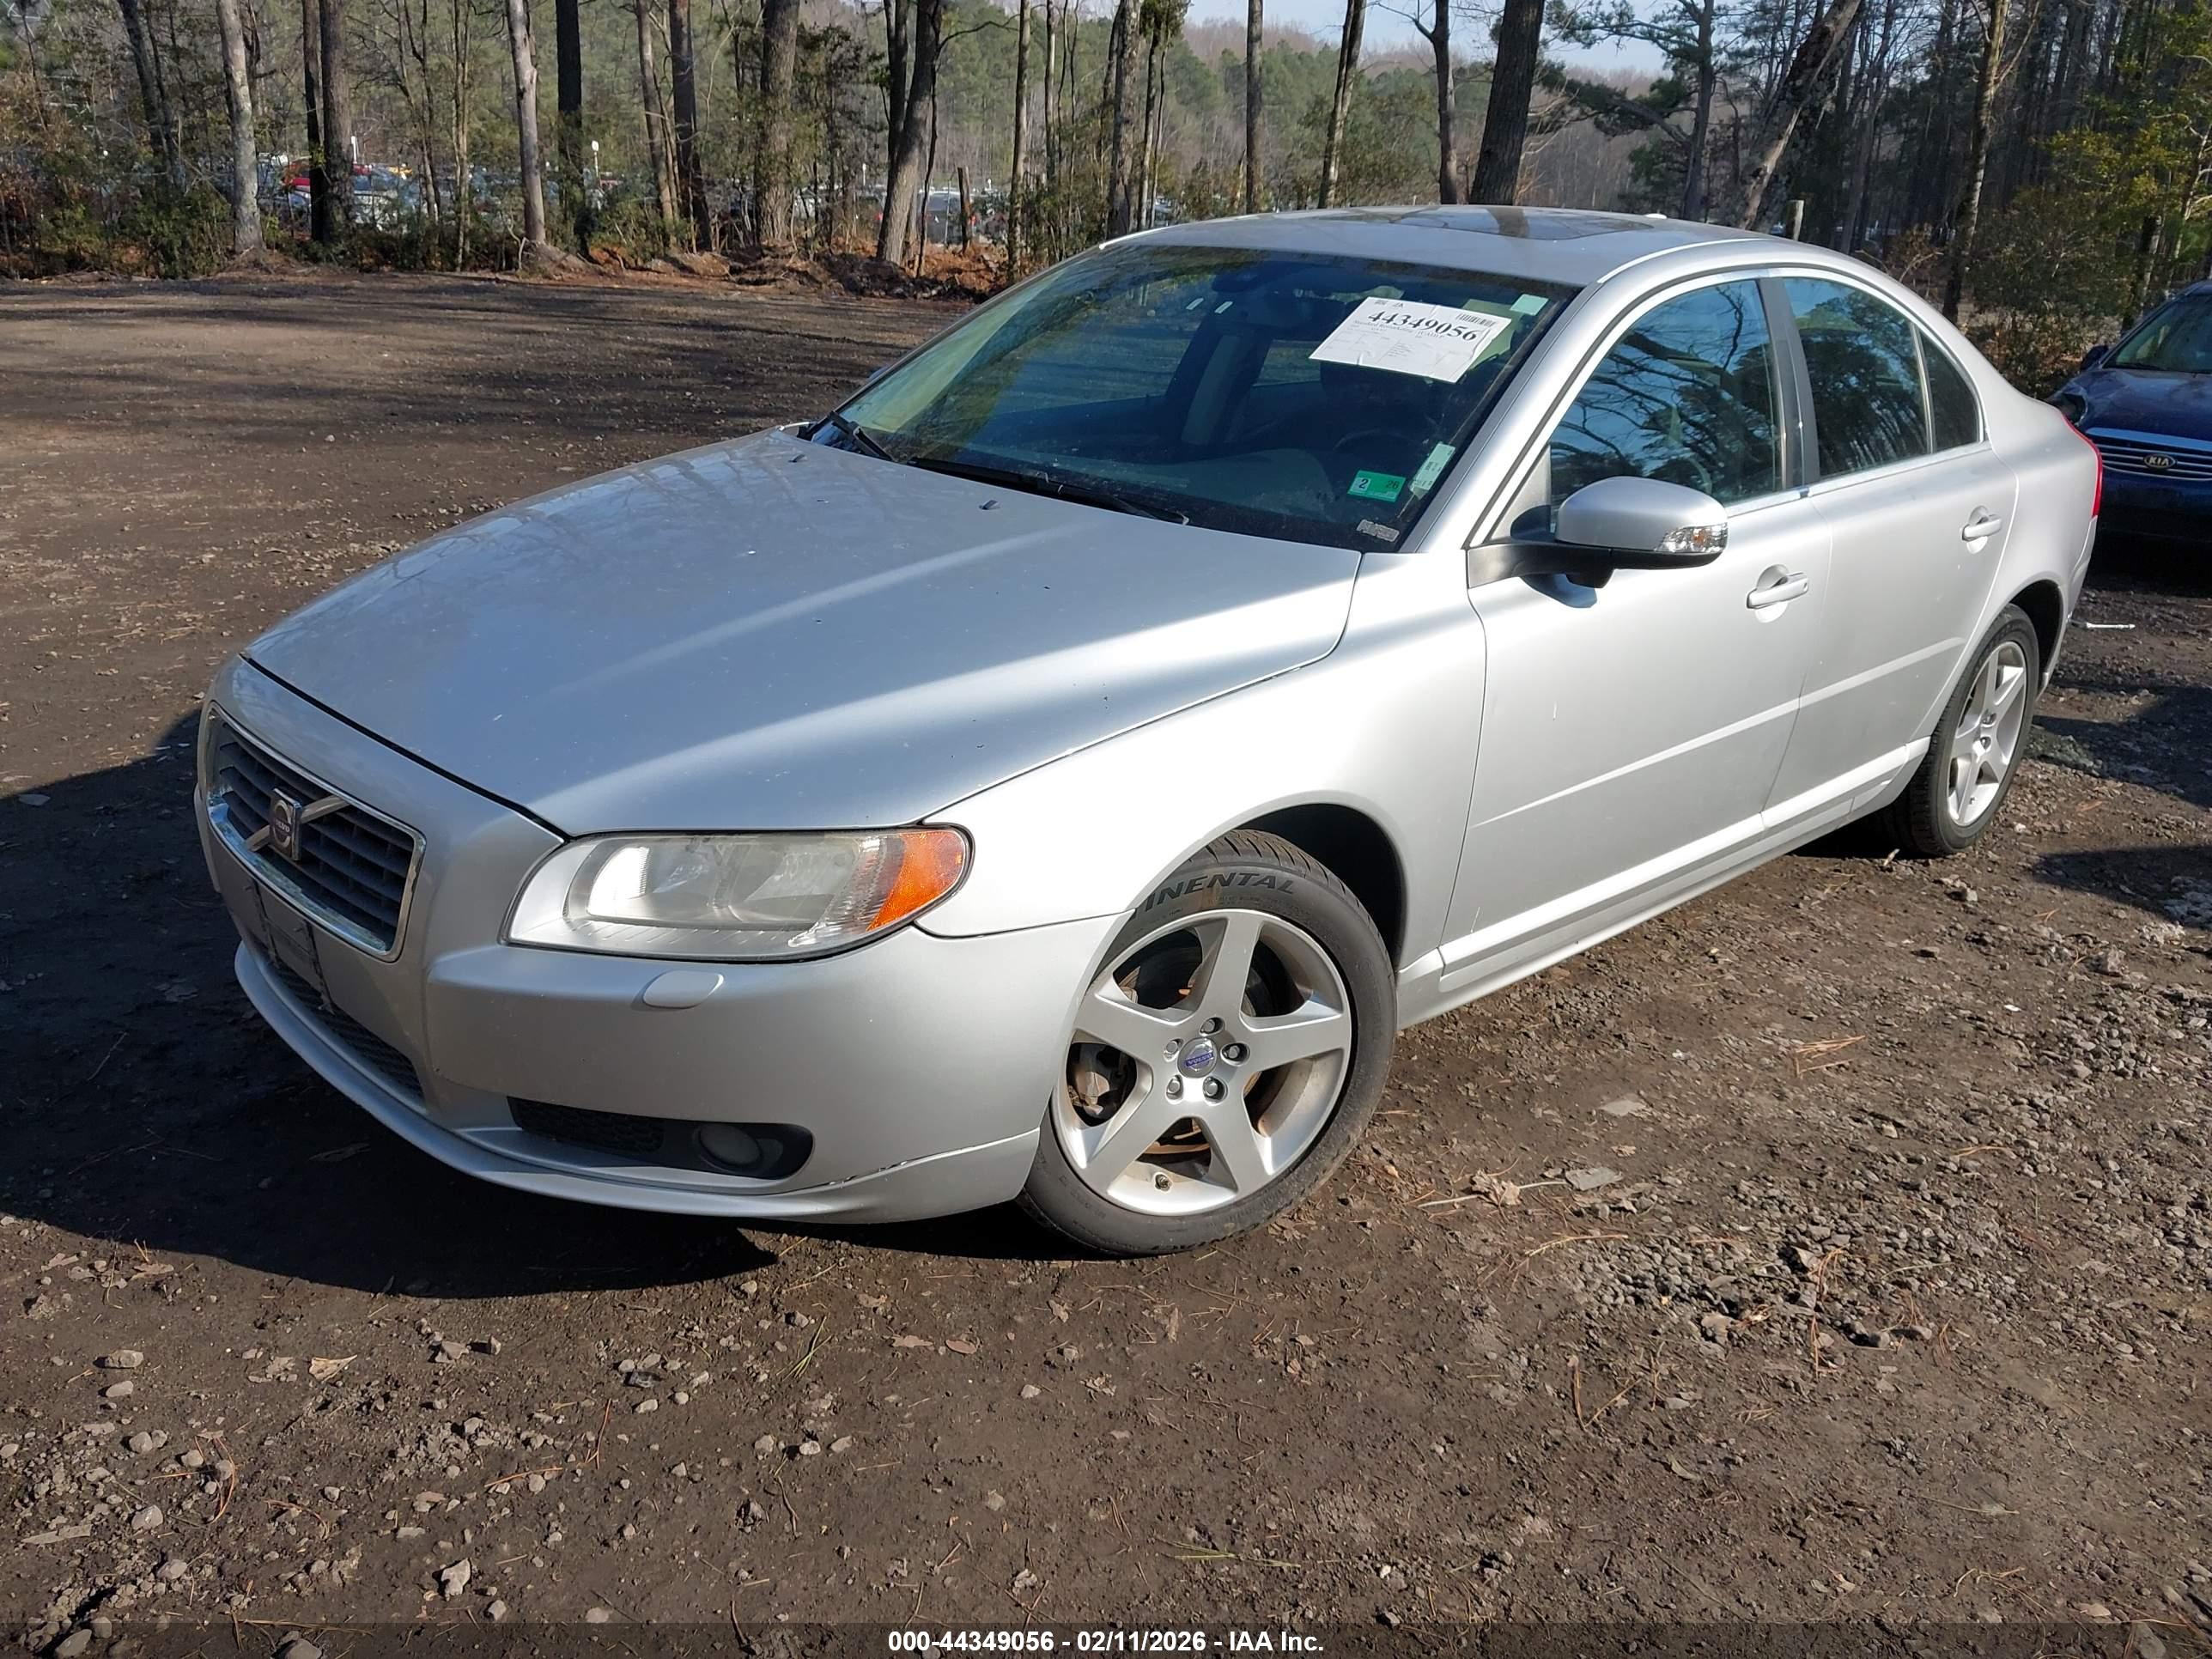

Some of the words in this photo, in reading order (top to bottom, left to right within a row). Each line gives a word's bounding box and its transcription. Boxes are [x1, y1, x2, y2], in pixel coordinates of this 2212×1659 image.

[1368, 310, 1478, 341] 44349056
[2148, 456, 2169, 466] KIA
[1358, 477, 1369, 489] 2
[1129, 872, 1294, 920] INENTAL
[1187, 1052, 1212, 1065] VOLVO
